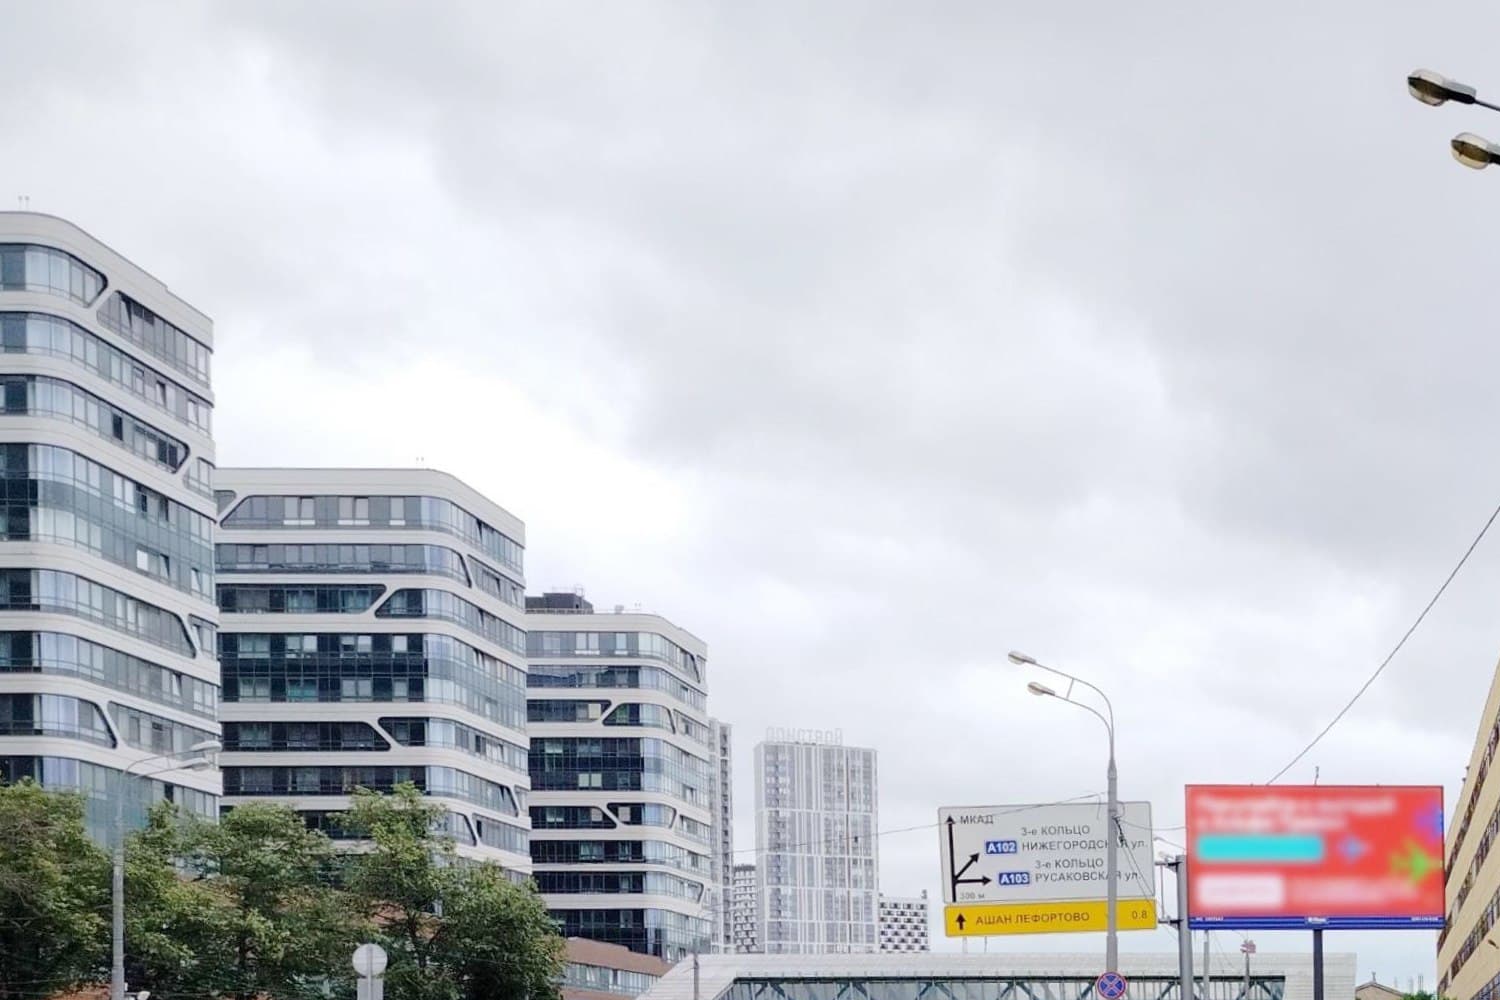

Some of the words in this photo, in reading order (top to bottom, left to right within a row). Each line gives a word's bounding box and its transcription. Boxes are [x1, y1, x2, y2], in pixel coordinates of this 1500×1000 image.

[960, 815, 994, 825] МКАД
[1041, 825, 1090, 836] КОЛЬЦО
[987, 842, 1017, 853] А102
[1021, 838, 1129, 851] НИЖЕГОРОДСЯ
[1054, 858, 1104, 869] КОЛЬЦО
[1000, 872, 1030, 884] А103
[975, 914, 1012, 925] АШАН
[1015, 912, 1090, 924] ЛЕФОРТОВО
